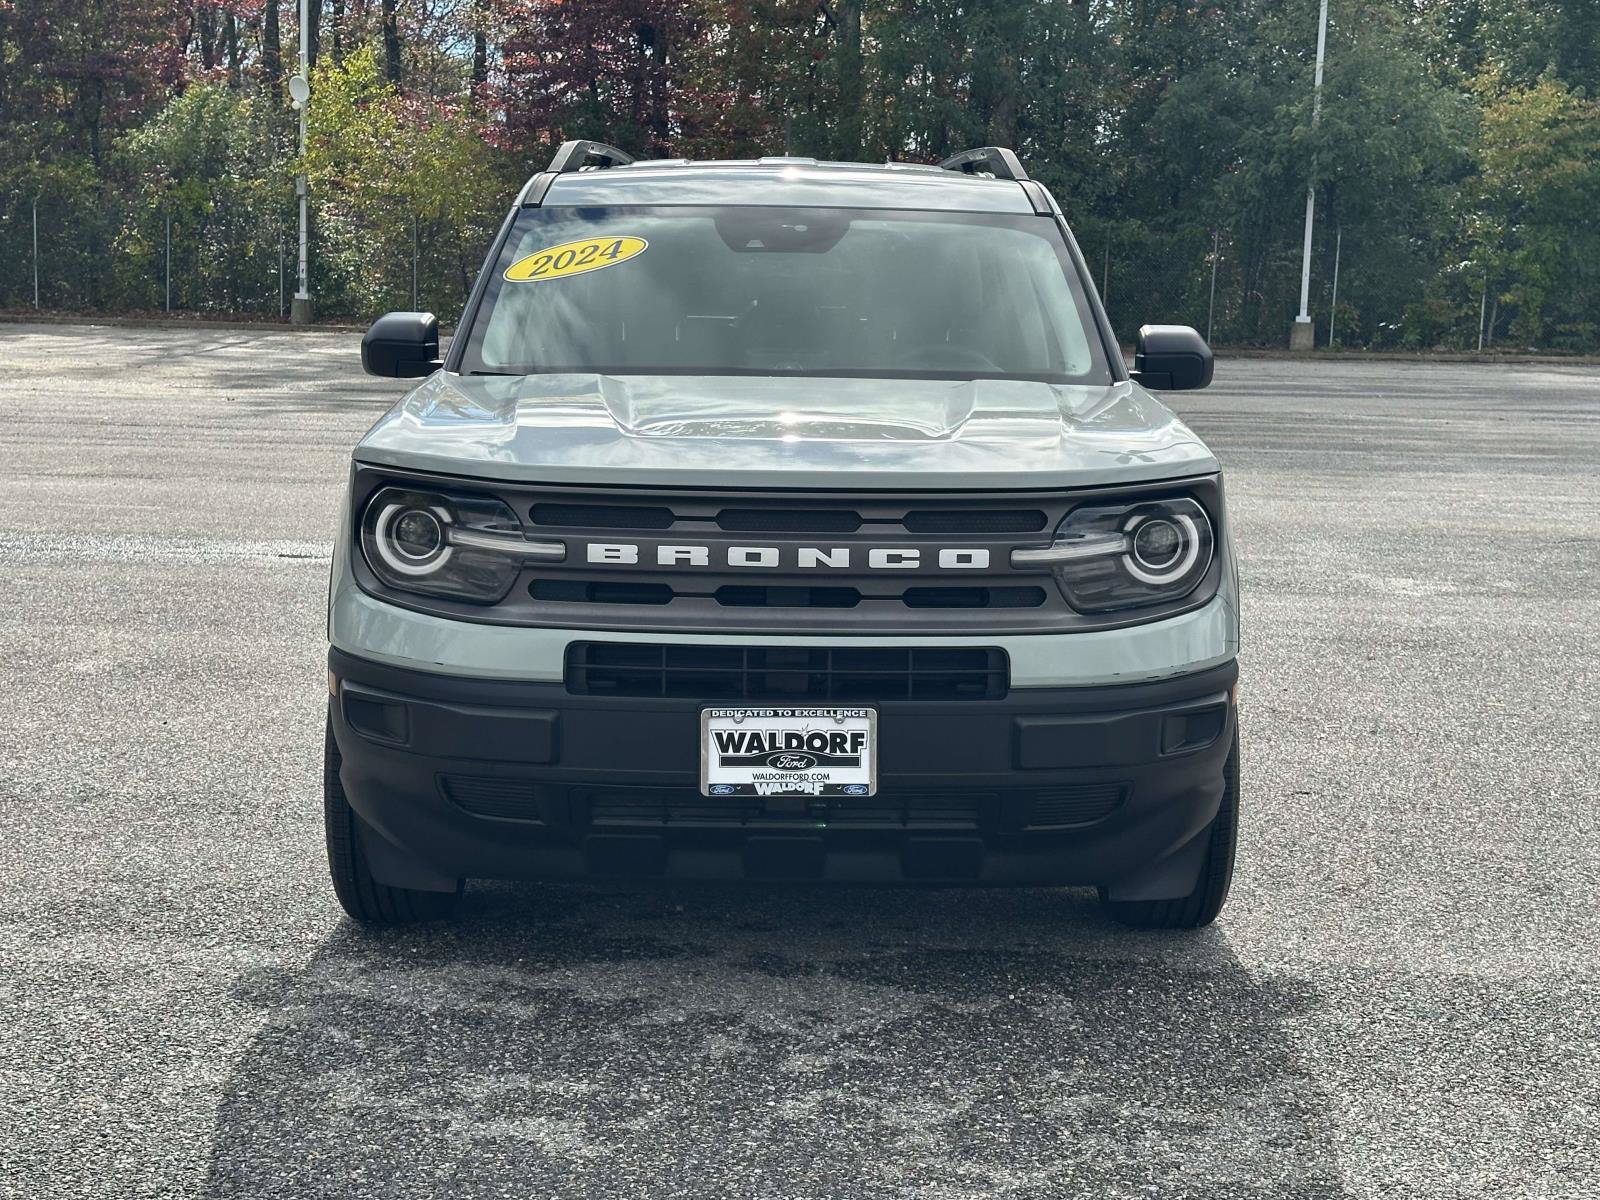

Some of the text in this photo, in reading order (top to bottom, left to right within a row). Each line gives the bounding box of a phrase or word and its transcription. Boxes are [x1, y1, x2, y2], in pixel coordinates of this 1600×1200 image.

[527, 239, 624, 278] 2024
[586, 543, 990, 569] BRONCO
[711, 709, 867, 717] DEDICATED TO EXCELLENCE
[712, 731, 867, 755] WALDORF
[776, 755, 808, 769] Ford
[752, 773, 830, 781] WALDORFFORD.COM
[753, 781, 825, 796] WALDORF
